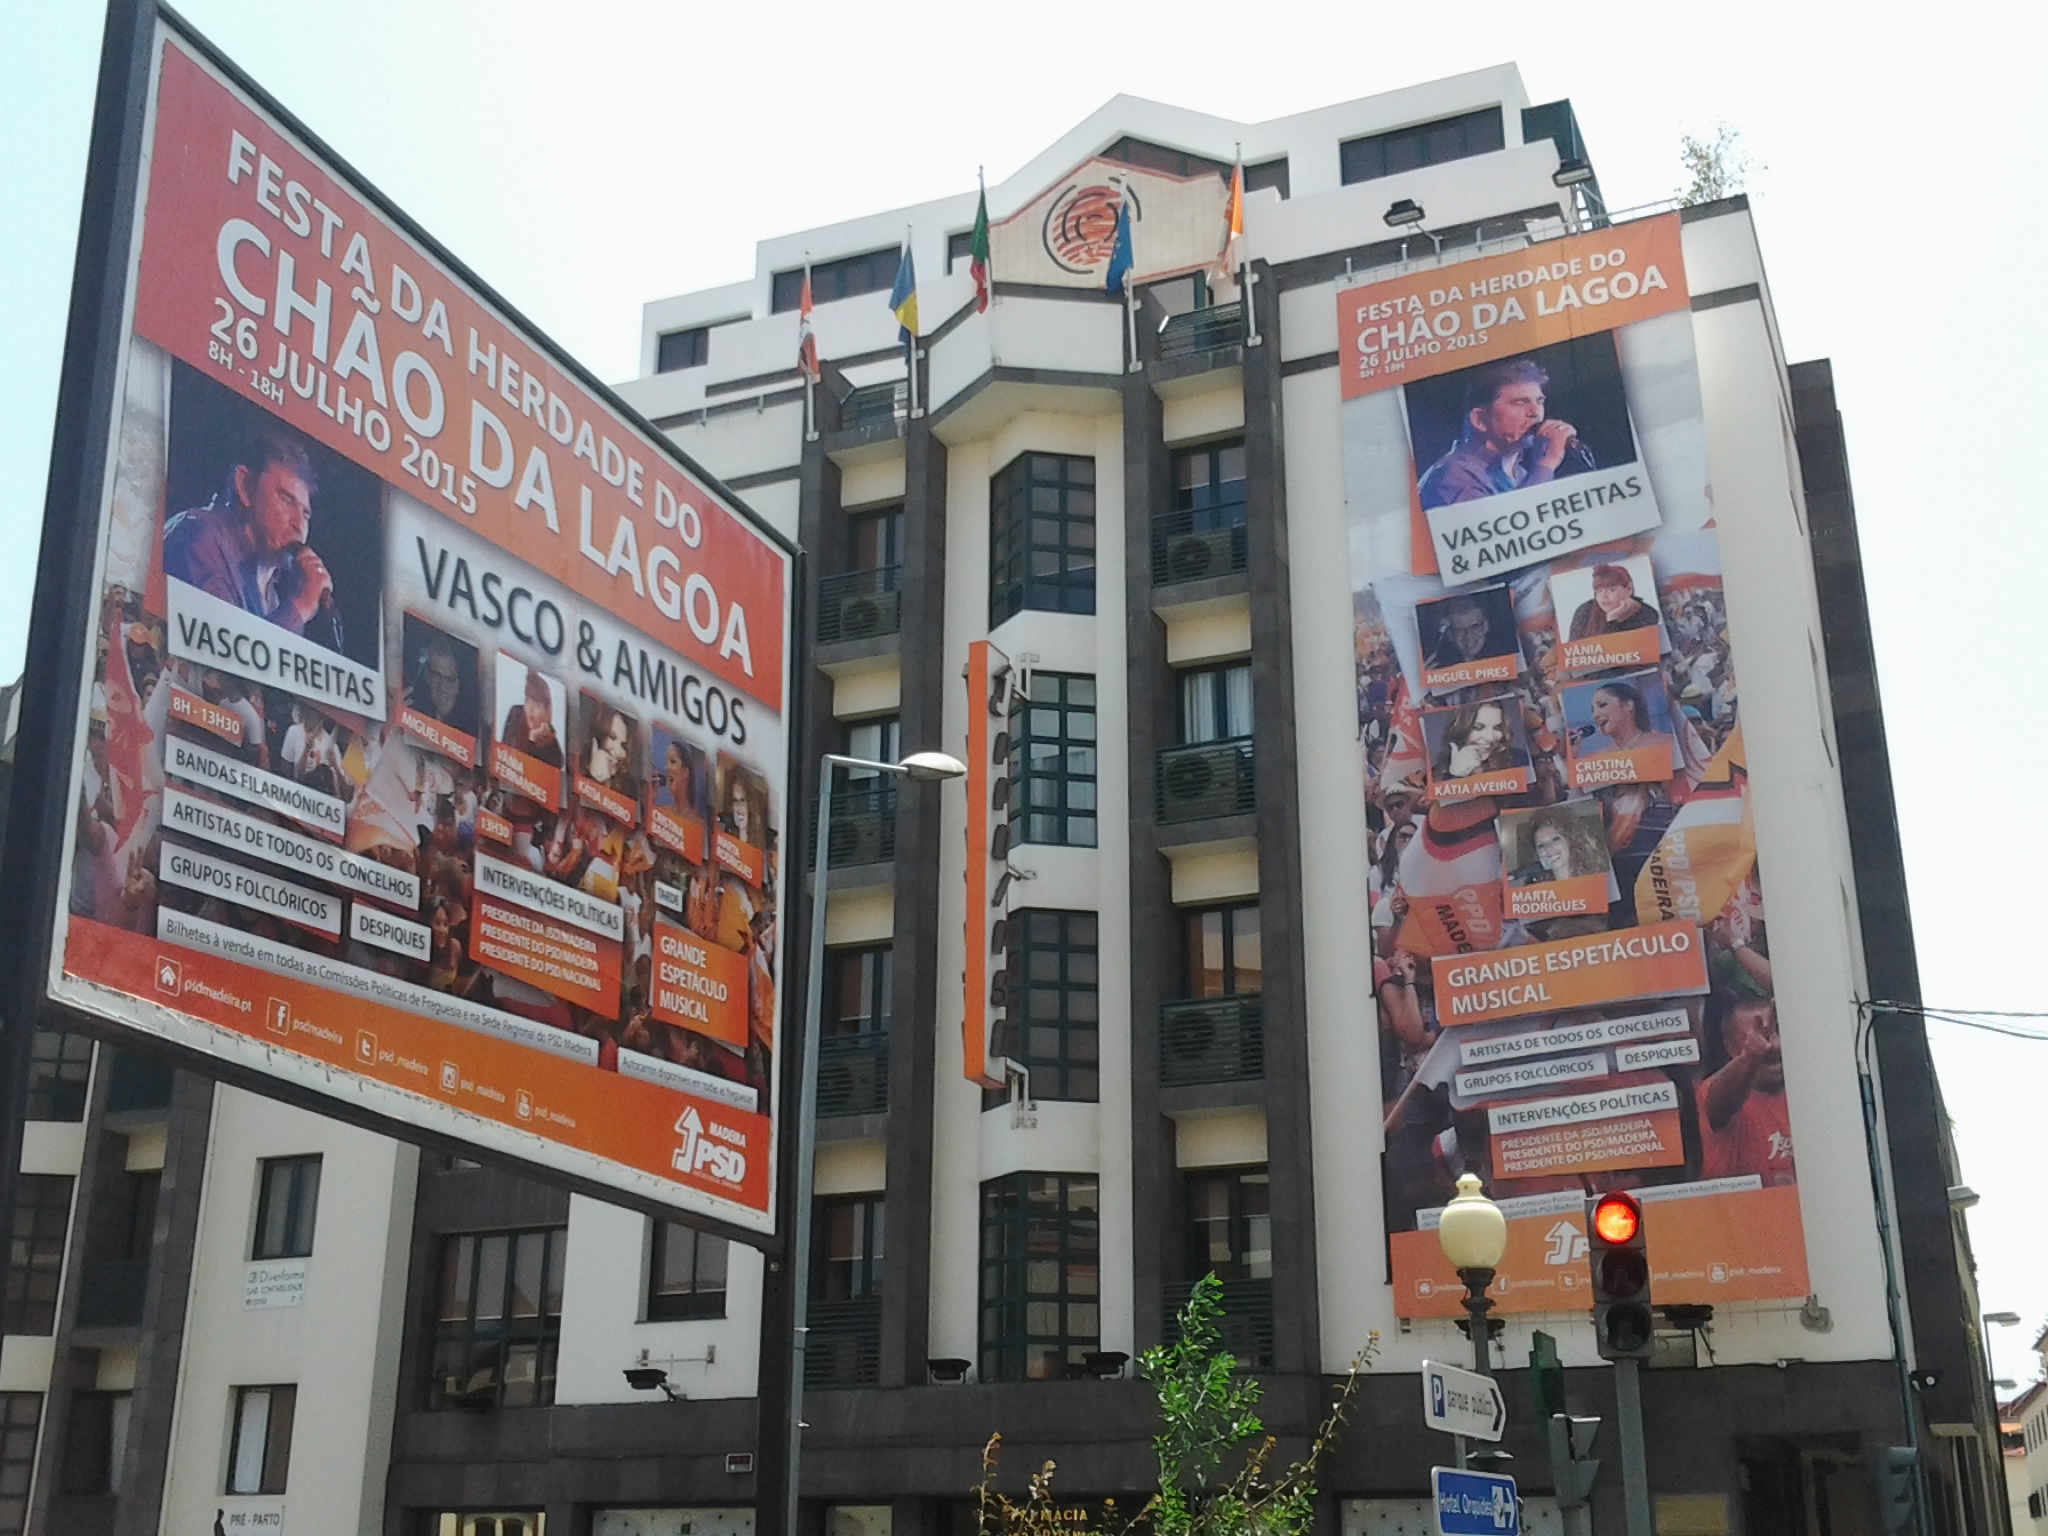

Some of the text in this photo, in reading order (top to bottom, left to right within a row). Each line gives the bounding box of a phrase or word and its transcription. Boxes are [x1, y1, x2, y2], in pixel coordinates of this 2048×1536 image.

[1356, 248, 1626, 324] FESTA DA HERDADE DO
[1357, 265, 1668, 354] CHÃO DA LAGOA
[227, 128, 702, 548] FESTA DA HERDADE DO
[1359, 330, 1489, 370] 26 JULHO 2015
[208, 340, 233, 370] 8H
[250, 370, 284, 406] 18H
[1359, 369, 1375, 379] 8H
[1385, 362, 1405, 373] 18H
[211, 297, 477, 514] 26 JULHO 2015
[216, 217, 753, 678] CHÃO DA LAGOA
[1441, 476, 1642, 551] VASCO FREITAS
[1451, 518, 1584, 575] & AMIGOS
[177, 613, 375, 706] VASCO FREITAS
[416, 535, 747, 745] VASCO & AMIGOS
[1565, 651, 1641, 668] FERNANDES
[1427, 667, 1510, 684] MIGUEL PIRES
[173, 697, 191, 715] 8H
[201, 708, 241, 735] 13H30
[402, 711, 470, 762] MIGUEL PIRES
[495, 762, 548, 803] FERNANDES
[1575, 758, 1635, 772] CRISTINA
[1576, 768, 1638, 785] BARBOSA
[176, 748, 342, 824] BANDAS FILARMÓNICAS
[1434, 779, 1518, 797] KÁTIA AVEIRO
[173, 801, 414, 898] ARTISTAS DE TODOS OS CONCELHOS
[171, 855, 328, 920] GRUPOS FOLCLÓRICOS
[482, 864, 620, 931] INTERVENÇÕES POLÍTICAS
[1512, 889, 1557, 903] MARTA
[1650, 845, 1675, 921] ADEIRA
[481, 903, 530, 931] PRESIDENTE
[1512, 899, 1587, 915] RODRIGUES
[359, 915, 426, 951] DESPIQUES
[480, 922, 530, 950] PRESIDENTE
[532, 938, 545, 953] DO
[660, 935, 707, 969] GRANDE
[167, 918, 211, 945] Bilhetes
[213, 933, 219, 947] à
[222, 938, 255, 958] venda
[257, 949, 274, 965] em
[276, 953, 305, 972] todas
[306, 964, 317, 976] as
[319, 965, 369, 992] Comissões
[410, 992, 421, 1005] de
[479, 941, 530, 967] PRESIDENTE
[531, 956, 545, 971] DO
[1447, 932, 1690, 988] GRANDE ESPETÁCULO
[659, 961, 728, 1002] ESPETÁCULO
[1452, 983, 1552, 1016] MUSICAL
[659, 989, 709, 1023] MUSICAL
[1469, 1016, 1682, 1058] ARTISTAS DE TODOS OS CONCELHOS
[1464, 1045, 1693, 1090] GRUPOS FOLCLÓRICOS DESPIQUES
[1497, 1089, 1670, 1127] INTERVENÇÕES POLÍTICAS
[1501, 1132, 1561, 1150] PRESIDENTE
[1564, 1130, 1579, 1141] DA
[1502, 1143, 1562, 1161] PRESIDENTE
[1565, 1140, 1581, 1152] DO
[694, 1138, 747, 1184] PSD
[1503, 1154, 1563, 1172] PRESIDENTE
[1566, 1152, 1583, 1163] DO
[230, 1512, 246, 1526] PRÉ
[252, 1513, 280, 1526] PARTO
[1439, 1491, 1461, 1514] Hotel
